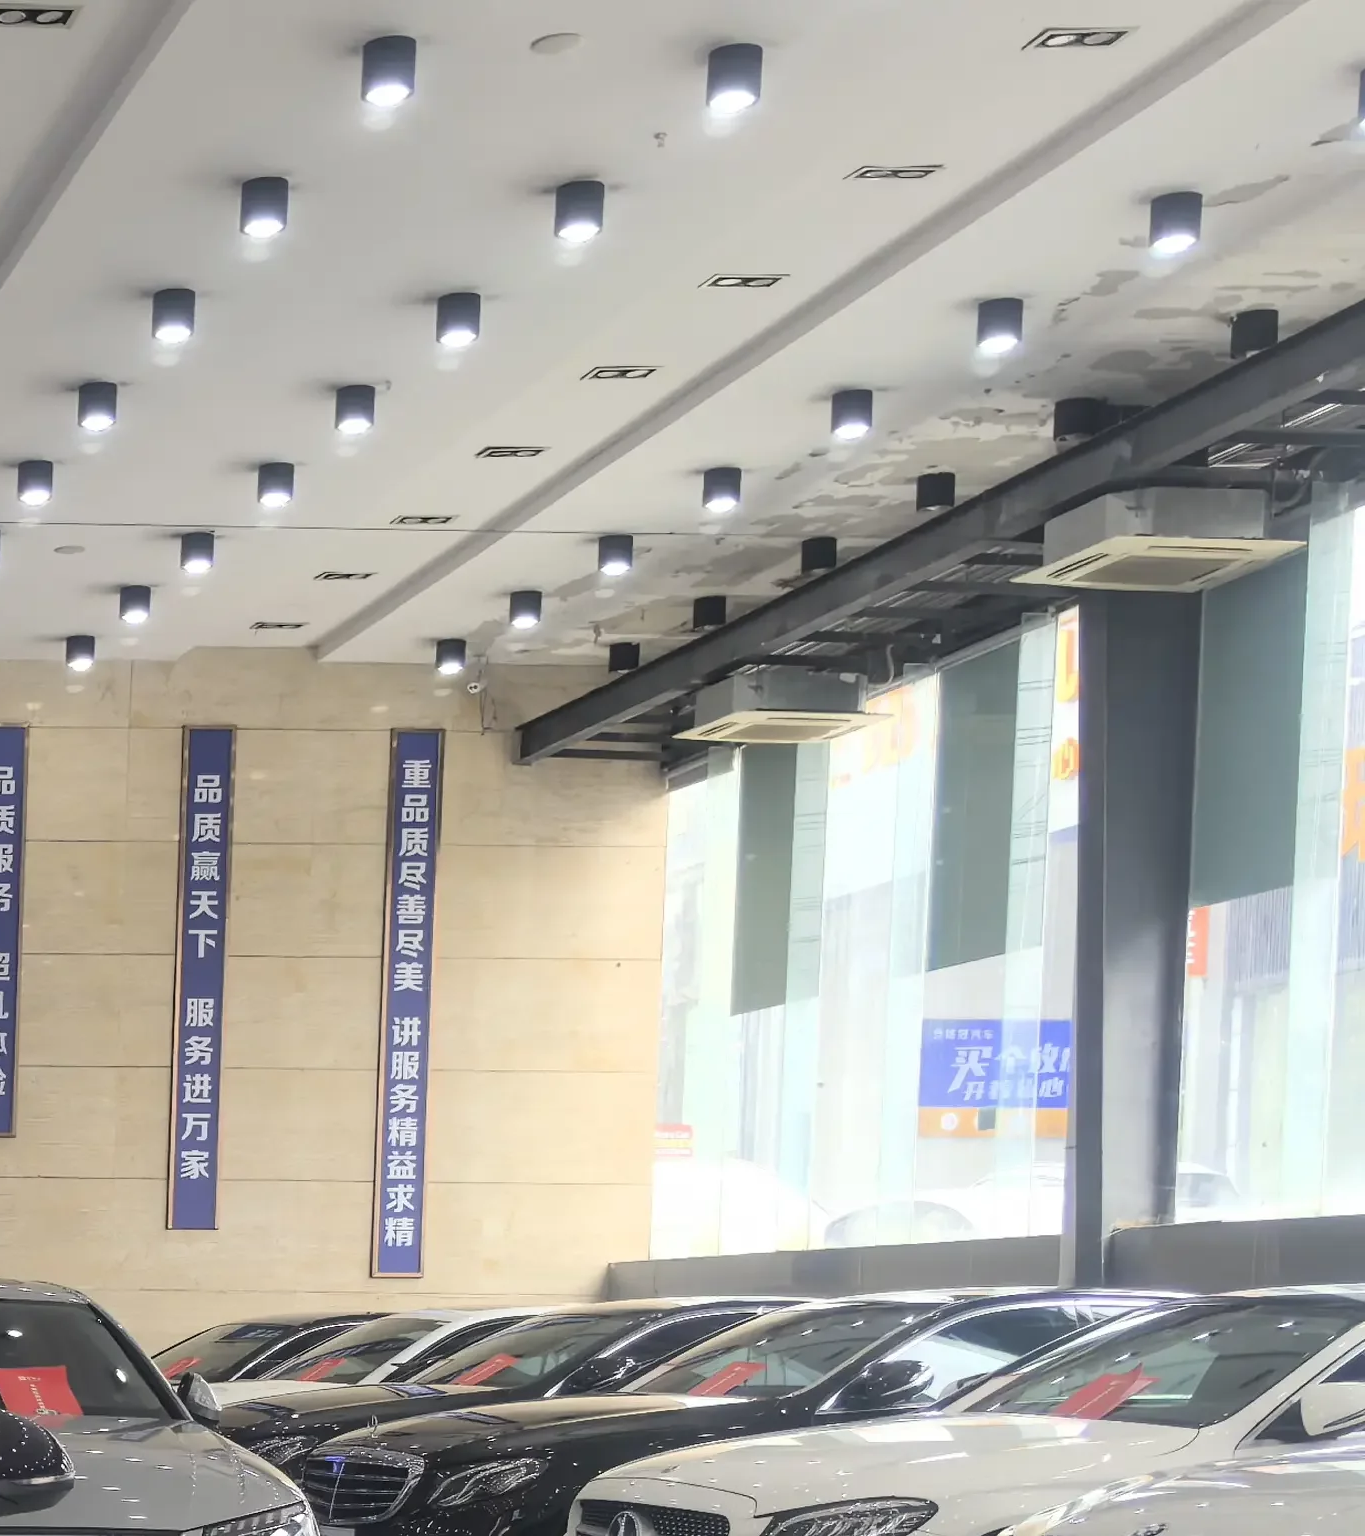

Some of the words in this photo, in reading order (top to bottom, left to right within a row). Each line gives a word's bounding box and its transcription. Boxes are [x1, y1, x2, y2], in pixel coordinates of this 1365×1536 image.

[188, 774, 223, 960] 品质赢天下
[393, 758, 432, 994] 重品质尽善尽美
[179, 996, 215, 1180] 服务进万家
[382, 1015, 422, 1248] 讲服务精益求精
